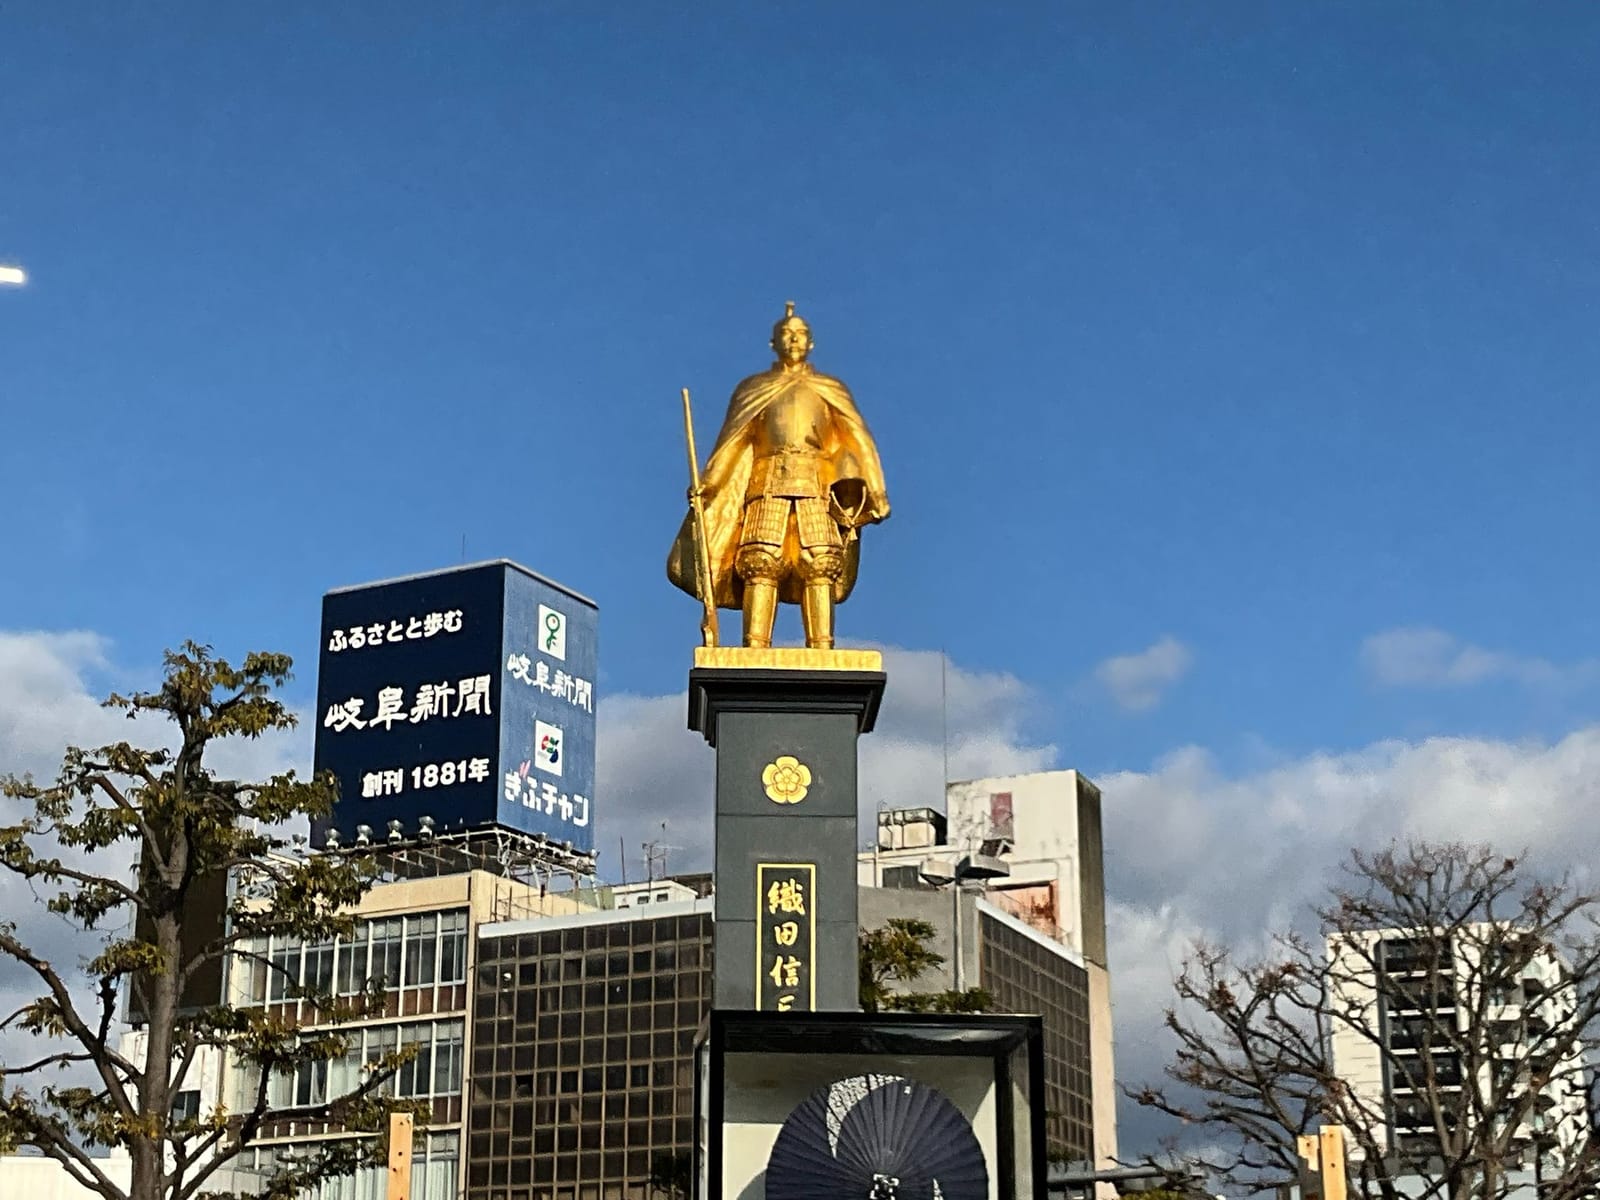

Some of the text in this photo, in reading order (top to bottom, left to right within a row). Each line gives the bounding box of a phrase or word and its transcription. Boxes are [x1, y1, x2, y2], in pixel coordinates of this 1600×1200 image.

[328, 609, 464, 652] ふるさとと歩む
[323, 674, 492, 733] 岐阜新聞
[506, 652, 592, 714] 岐阜新聞
[504, 760, 590, 828] ぎふチャン
